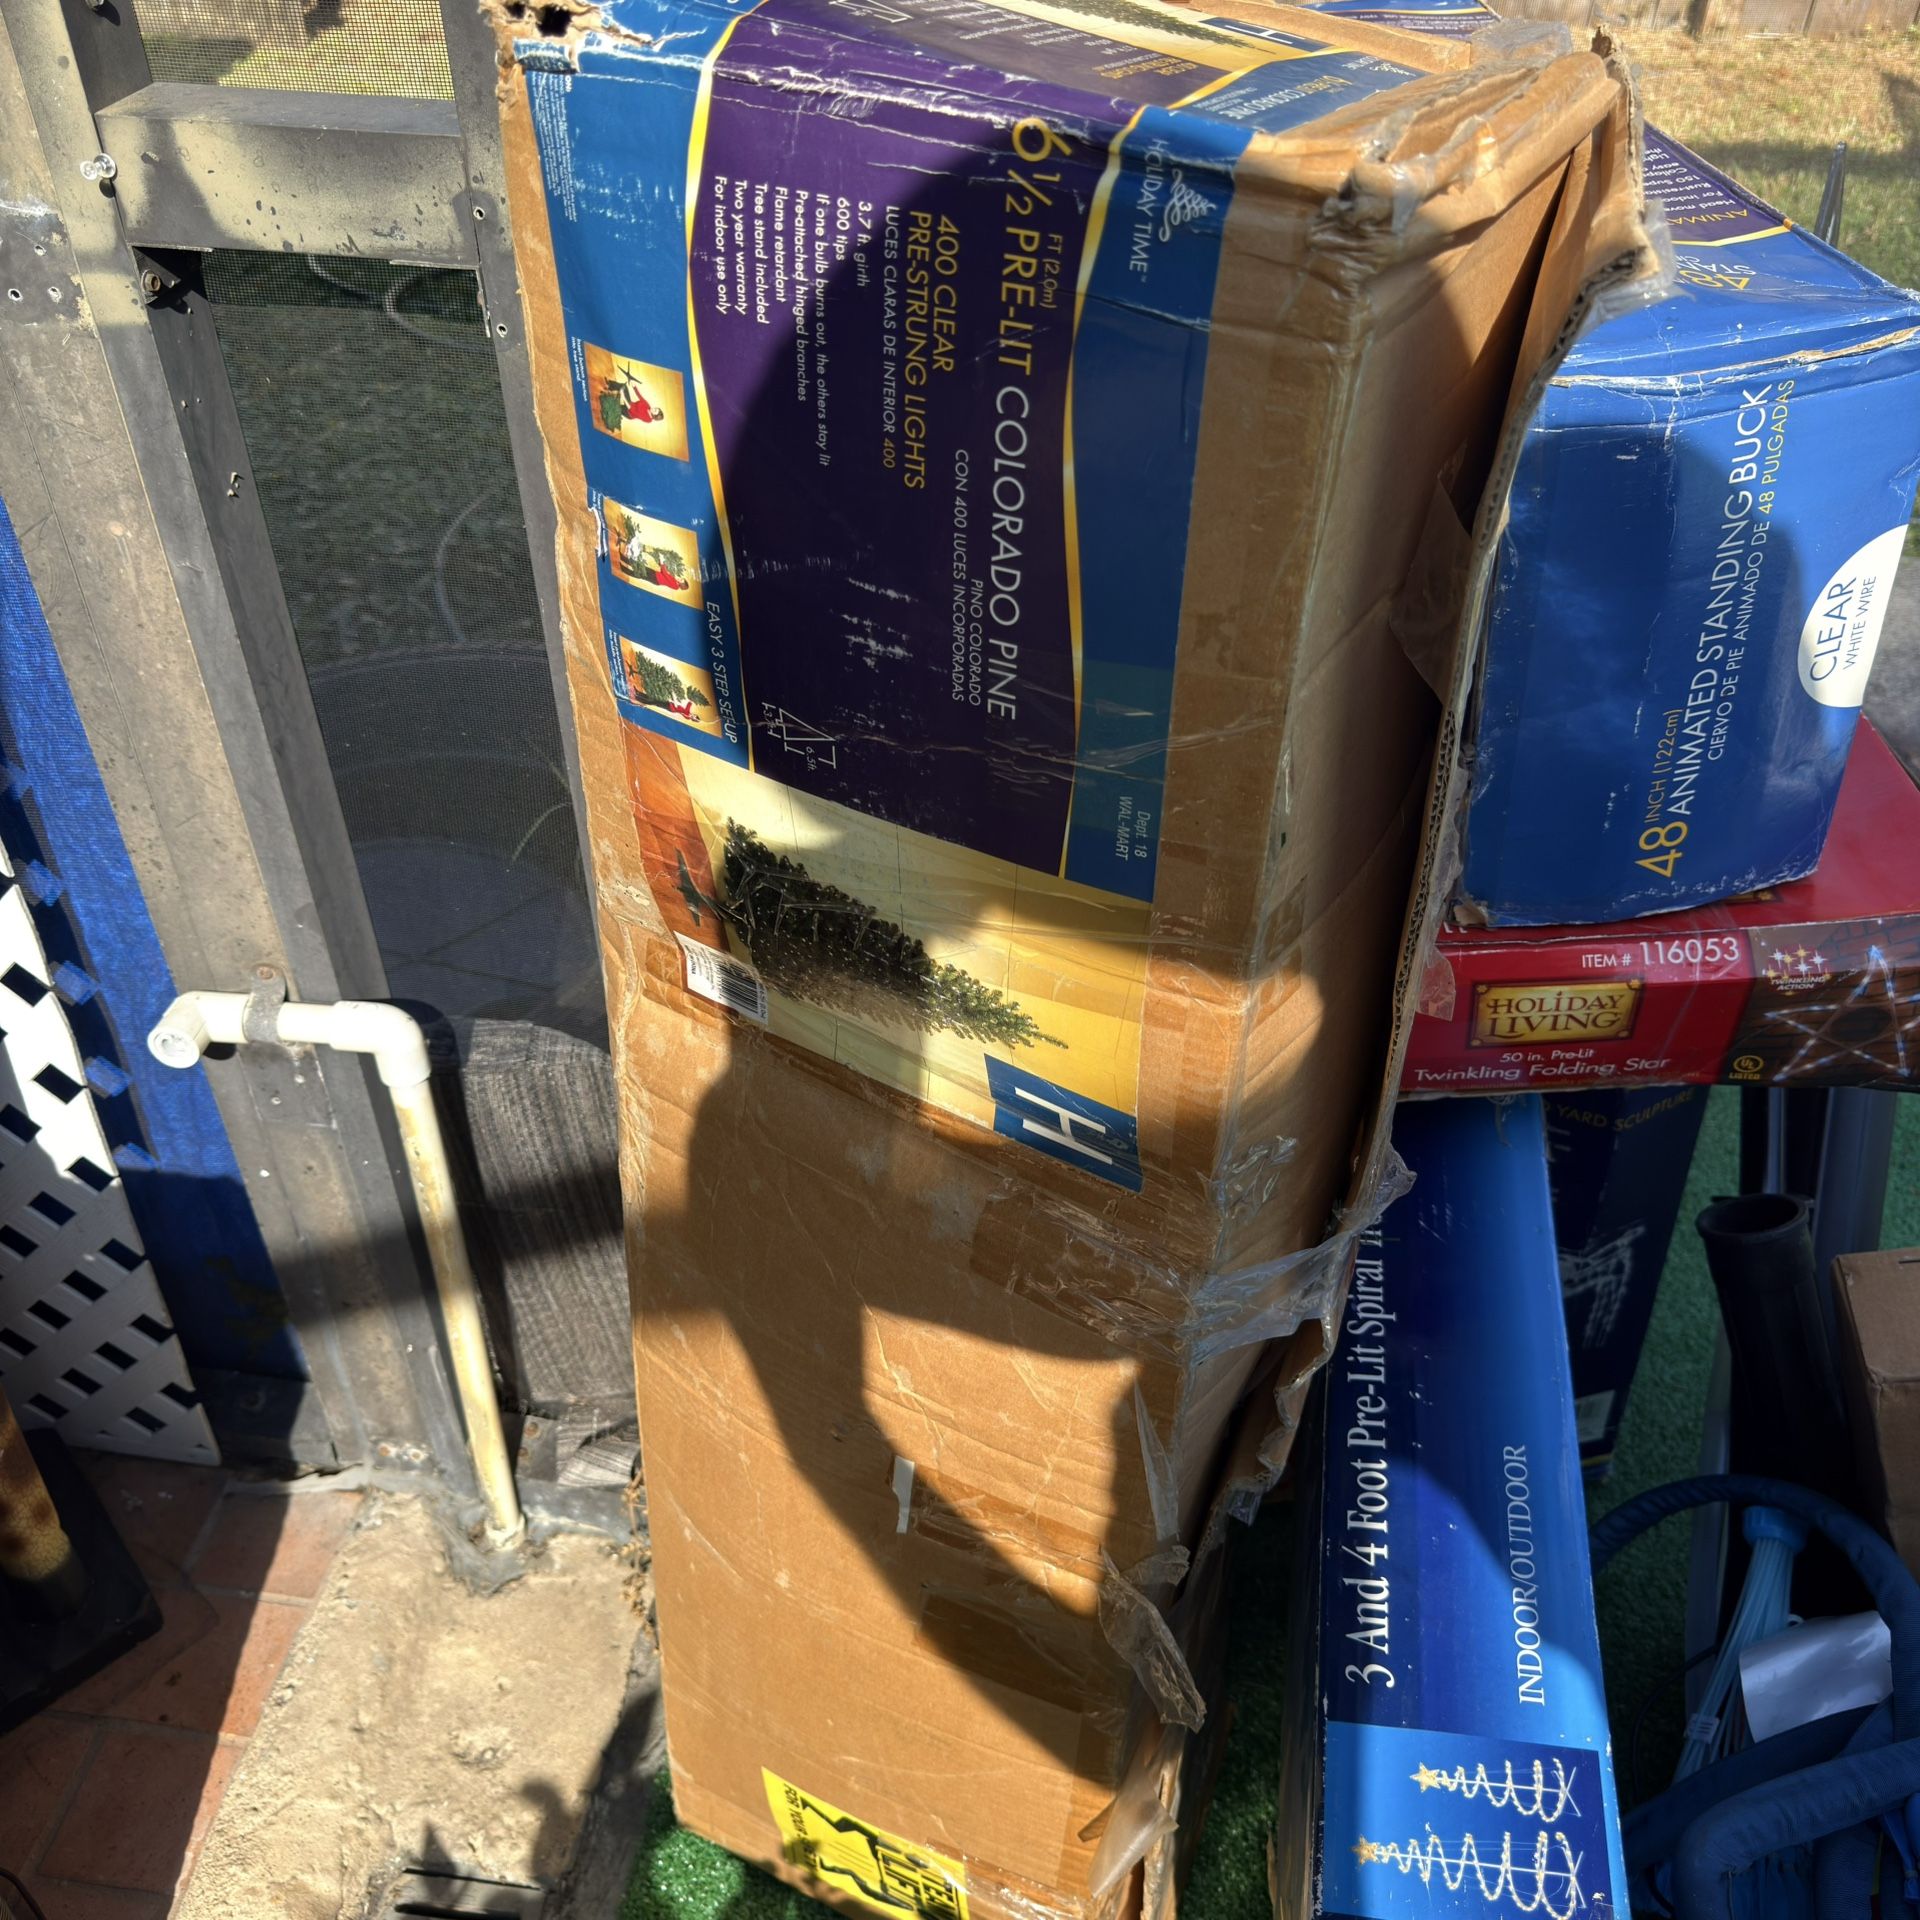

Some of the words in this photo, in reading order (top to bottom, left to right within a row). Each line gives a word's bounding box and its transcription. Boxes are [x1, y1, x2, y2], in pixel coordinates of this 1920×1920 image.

[1012, 117, 1073, 162] 6
[714, 174, 728, 202] For
[734, 179, 748, 210] Two
[753, 182, 768, 217] Tree
[816, 192, 831, 206] If
[1135, 138, 1170, 218] HOLIDAY
[713, 203, 727, 253] indoor
[731, 211, 746, 248] year
[774, 186, 789, 232] Flame
[815, 207, 826, 237] one
[836, 196, 851, 231] 600
[857, 200, 873, 231] 3.7
[753, 217, 770, 260] stand
[794, 188, 810, 284] Pre-attached
[832, 233, 850, 261] tips
[856, 232, 873, 247] ft.
[884, 205, 900, 259] LUCES
[934, 214, 961, 276] 400
[1047, 232, 1063, 254] FT
[714, 253, 727, 280] use
[773, 234, 788, 304] retardant
[814, 239, 830, 275] bulb
[853, 252, 871, 288] girth
[714, 281, 733, 315] only
[732, 249, 748, 316] warranty
[754, 261, 771, 325] included
[815, 276, 830, 319] burns
[883, 264, 898, 330] CLARAS
[904, 210, 933, 387] PRE-STRUNG
[998, 226, 1041, 376] PRE-LIT
[1039, 257, 1062, 309] (2.0m)
[1679, 269, 1750, 291] 48
[792, 284, 810, 338] hinged
[931, 284, 958, 372] CLEAR
[814, 320, 828, 349] out,
[882, 334, 896, 358] DE
[795, 338, 811, 402] branches
[816, 352, 830, 373] the
[816, 374, 831, 420] others
[882, 361, 896, 434] INTERIOR
[815, 420, 830, 451] stay
[882, 438, 896, 469] 400
[903, 393, 926, 490] LIGHTS
[1760, 379, 1795, 486] PULGADAS
[818, 453, 831, 467] lit
[954, 449, 970, 492] CON
[953, 495, 968, 529] 400
[988, 386, 1031, 626] COLORADO
[1757, 490, 1775, 515] 48
[952, 531, 967, 581] LUCES
[1751, 521, 1771, 547] DE
[969, 578, 984, 619] PINO
[1731, 550, 1764, 642] ANIMADO
[706, 601, 724, 646] EASY
[951, 583, 967, 702] INCORPORADAS
[1634, 820, 1689, 878] 48
[1666, 669, 1719, 816] ANIMATED
[1695, 490, 1753, 663] STANDING
[1728, 383, 1773, 485] BUCK
[1809, 577, 1858, 683] CLEAR
[1842, 621, 1866, 671] WHITE
[1856, 575, 1877, 622] WIRE
[710, 646, 725, 659] 3
[968, 622, 983, 706] COLORADO
[1725, 646, 1745, 673] PIE
[712, 661, 730, 697] STEP
[986, 637, 1019, 721] PINE
[1720, 675, 1739, 698] DE
[718, 698, 738, 744] SET-UP
[1652, 708, 1683, 775] (122cm)
[1707, 700, 1733, 761] CIERVO
[1643, 778, 1668, 825] INCH
[1115, 796, 1135, 861] WAL-MART
[1133, 842, 1148, 859] 18
[1581, 953, 1617, 969] ITEM
[1621, 953, 1633, 967] #
[1639, 936, 1740, 966] 116053
[1485, 990, 1626, 1016] HOLIDAY
[1485, 1011, 1623, 1039] LIVING
[1413, 1065, 1521, 1082] Twinkling
[1528, 1060, 1617, 1077] Folding
[1623, 1055, 1672, 1072] Star
[1500, 1052, 1523, 1063] 50
[1526, 1051, 1546, 1062] in.
[1550, 1048, 1595, 1060] Pre-Lit
[1014, 1086, 1114, 1166] H
[1556, 1103, 1608, 1128] YARD
[1613, 1086, 1696, 1133] SCULPTURE
[1346, 1259, 1397, 1337] Spiral
[1346, 1344, 1388, 1450] Pre-Lit
[1346, 1457, 1389, 1534] Foot
[1341, 1543, 1389, 1568] 4
[1503, 1444, 1546, 1707] INDOOR/OUTDOOR
[1341, 1575, 1391, 1655] And
[1344, 1662, 1396, 1689] 3
